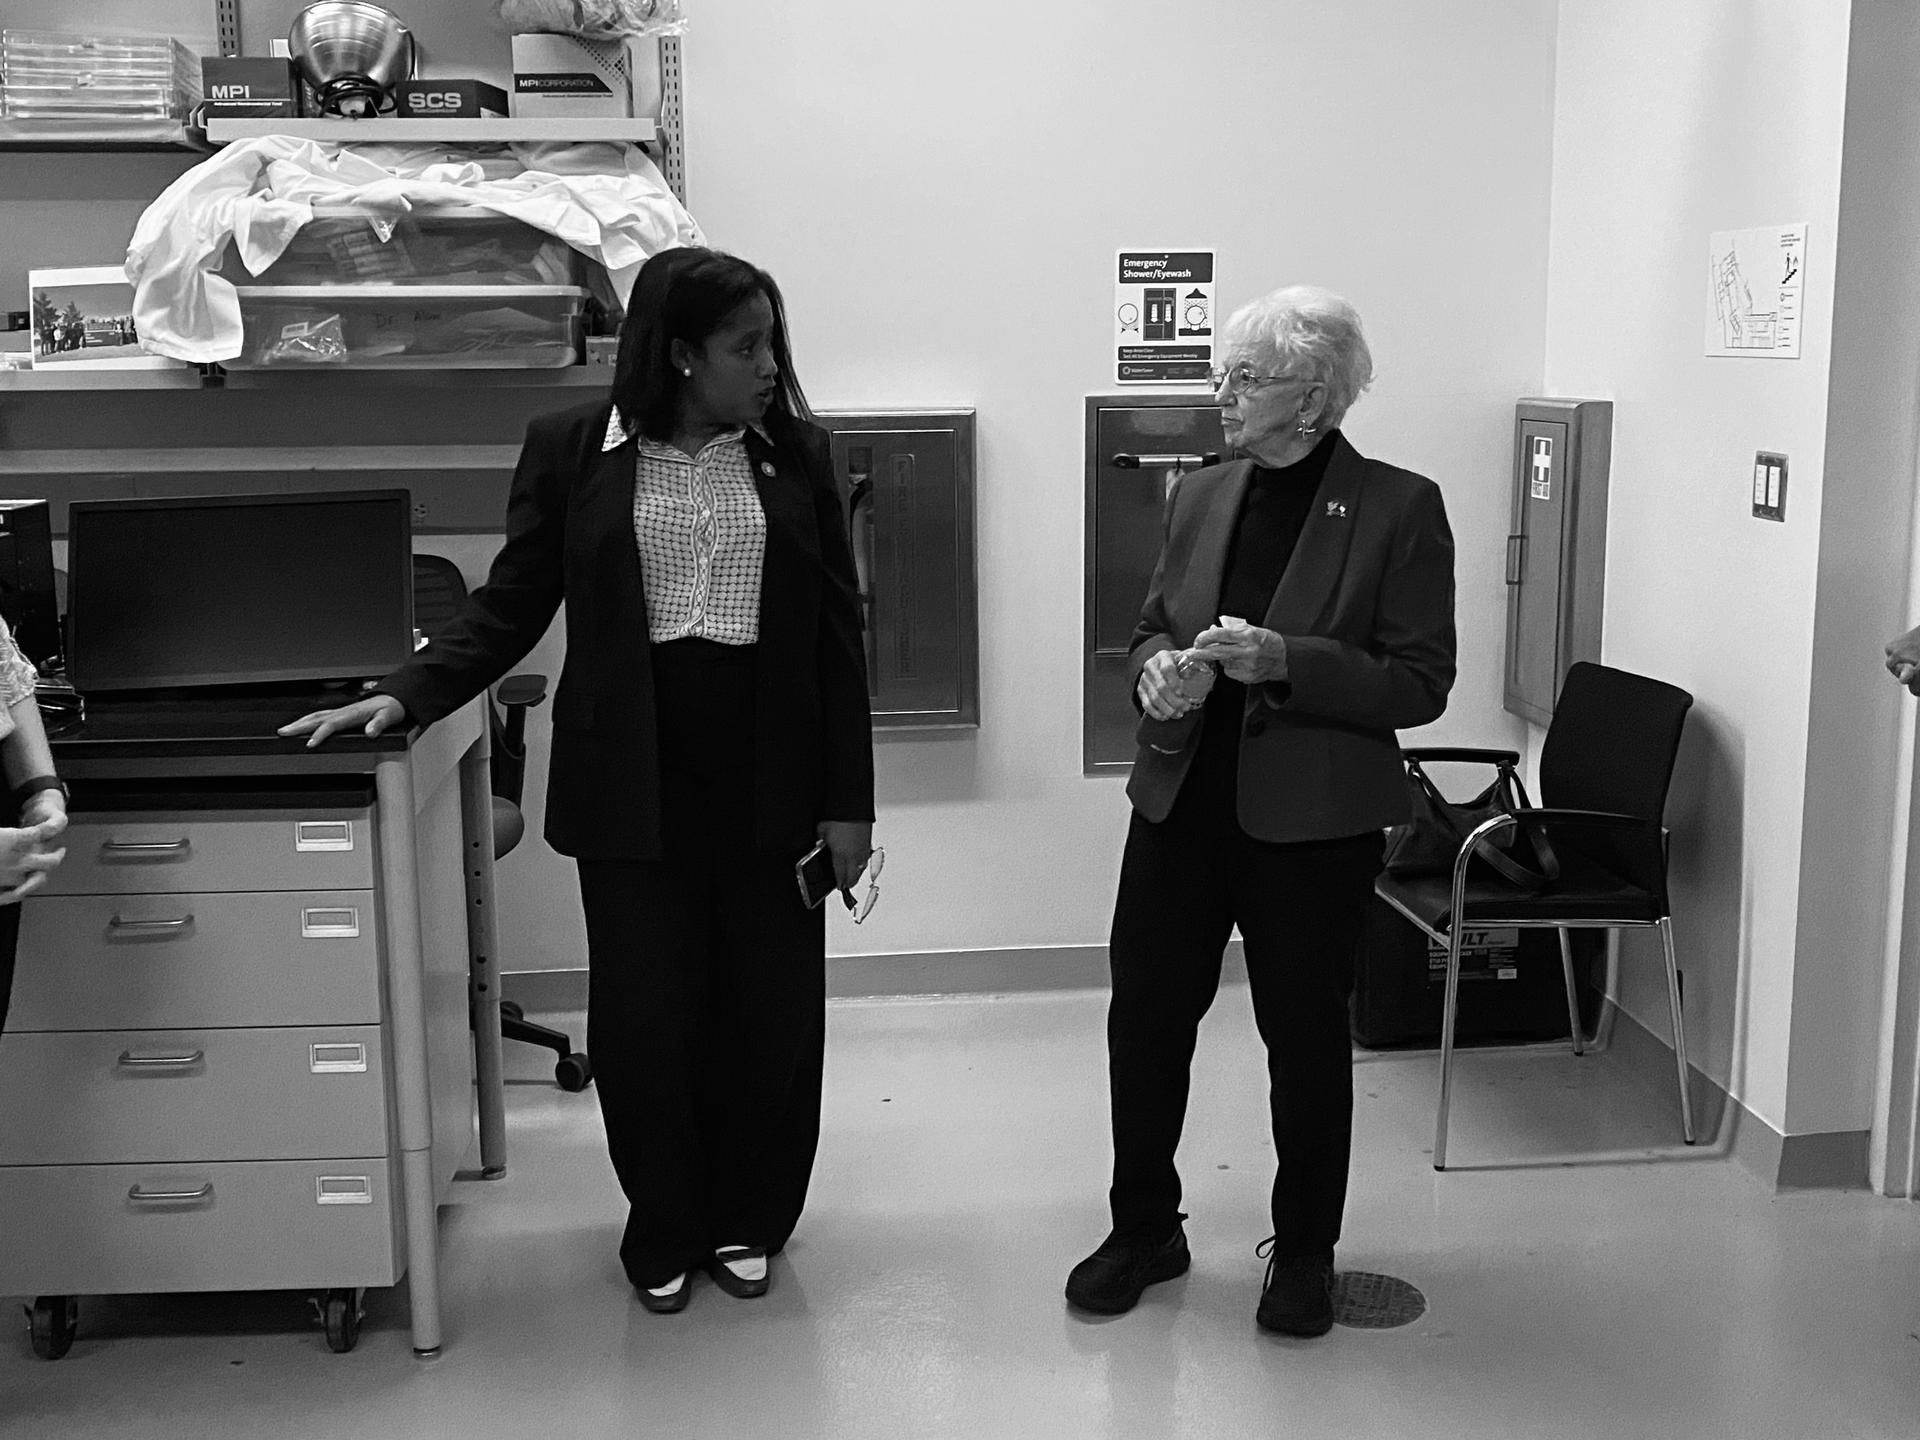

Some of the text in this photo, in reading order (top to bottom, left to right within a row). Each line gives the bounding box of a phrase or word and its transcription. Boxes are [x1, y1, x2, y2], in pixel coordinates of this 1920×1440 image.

[211, 85, 250, 99] MPI
[408, 92, 462, 108] SCS
[1123, 258, 1168, 270] Emergency
[1123, 268, 1192, 280] Shower/Eyewash
